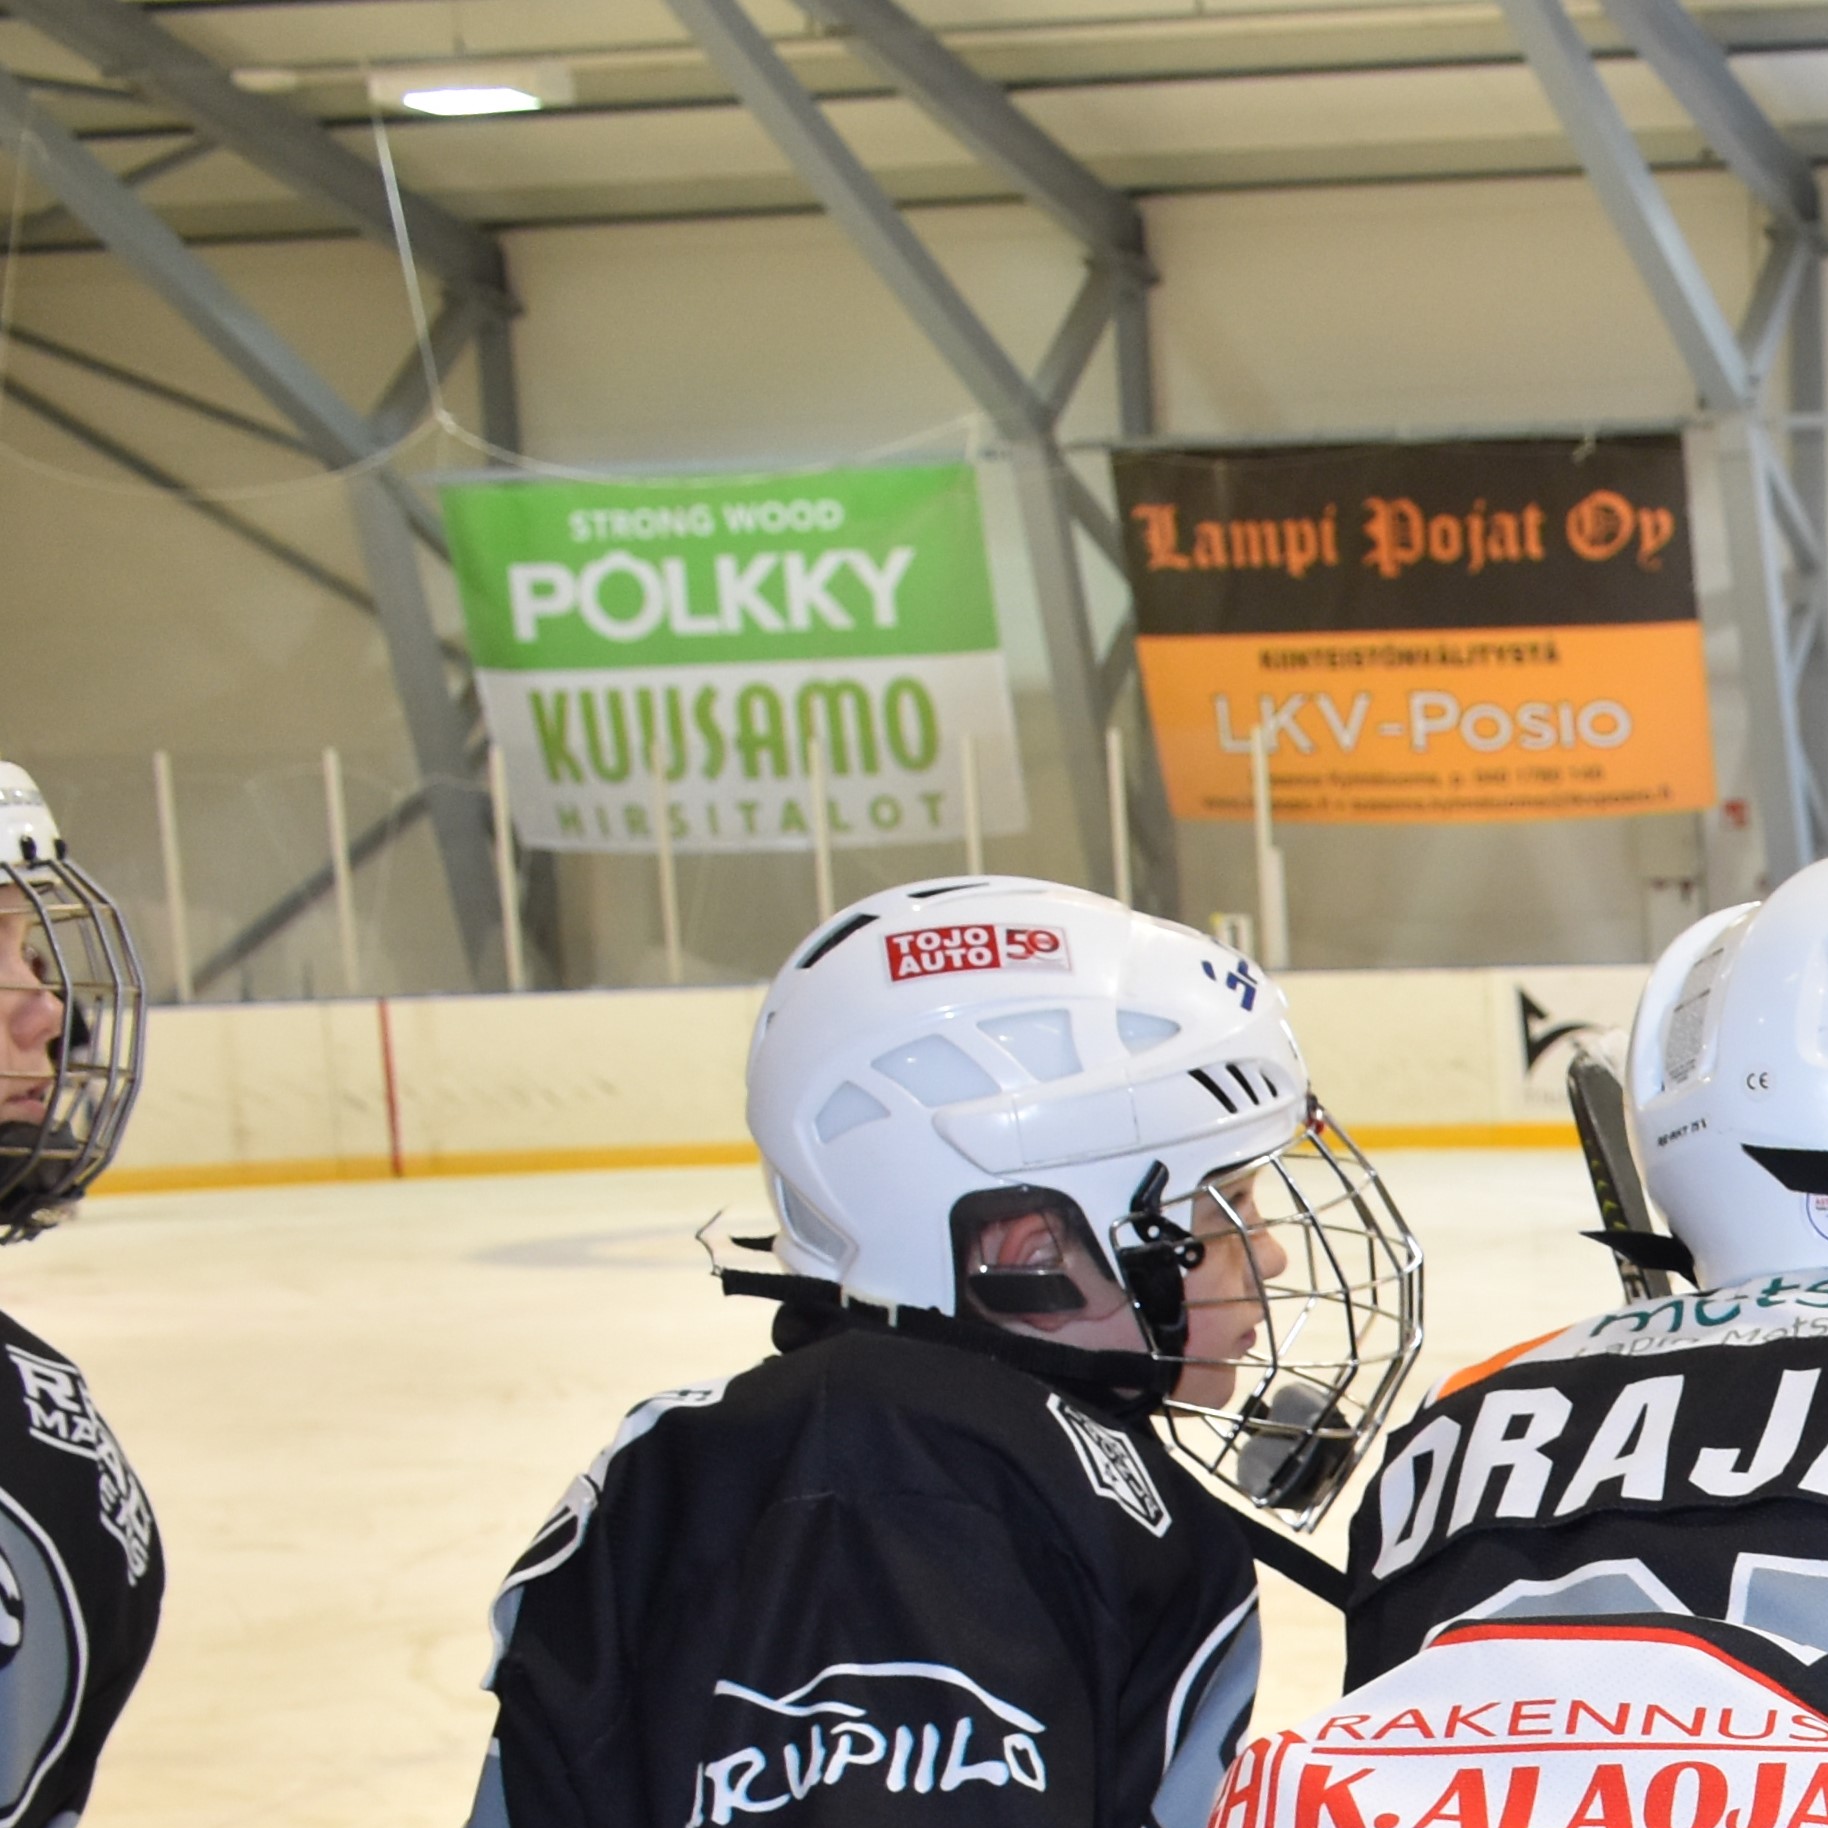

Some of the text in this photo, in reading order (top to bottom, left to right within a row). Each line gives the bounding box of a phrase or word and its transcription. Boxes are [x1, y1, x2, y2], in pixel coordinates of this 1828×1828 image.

[568, 499, 845, 543] STRONG WOOD
[1131, 489, 1675, 578] Lampi Pojat Oy
[527, 676, 940, 784] KUUSAMO
[557, 793, 945, 837] HIRSITALOT
[892, 926, 990, 954] TOJO
[898, 946, 993, 977] AUTO
